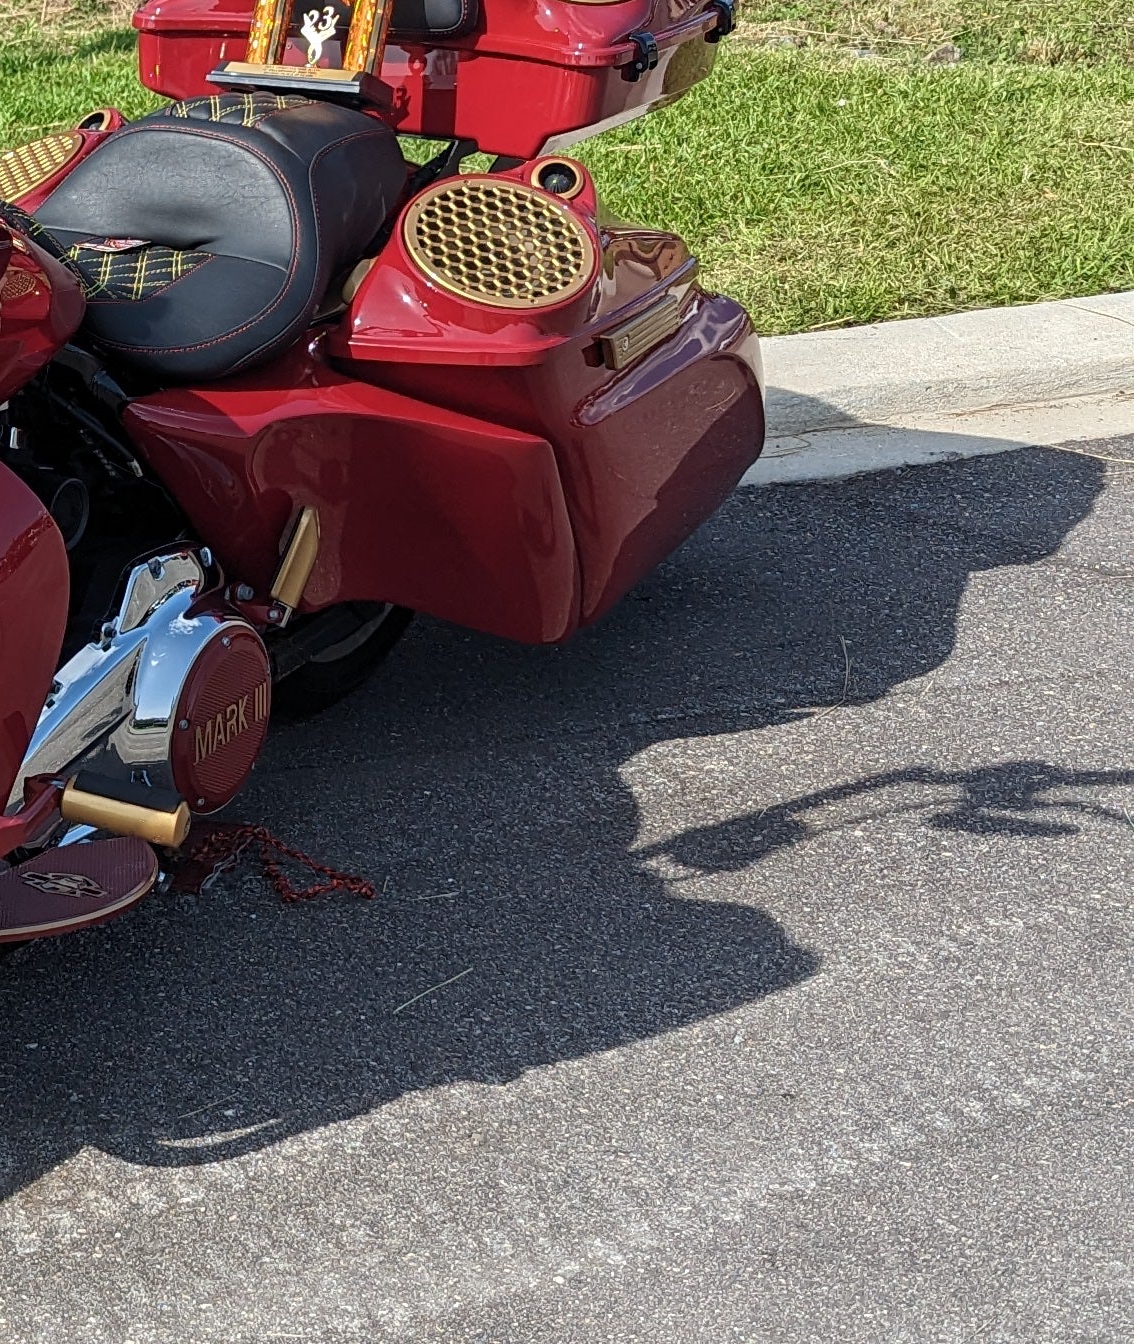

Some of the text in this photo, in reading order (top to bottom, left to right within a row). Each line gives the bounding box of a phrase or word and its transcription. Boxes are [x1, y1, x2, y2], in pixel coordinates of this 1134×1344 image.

[308, 6, 335, 31] 23
[193, 681, 267, 765] MARK III
